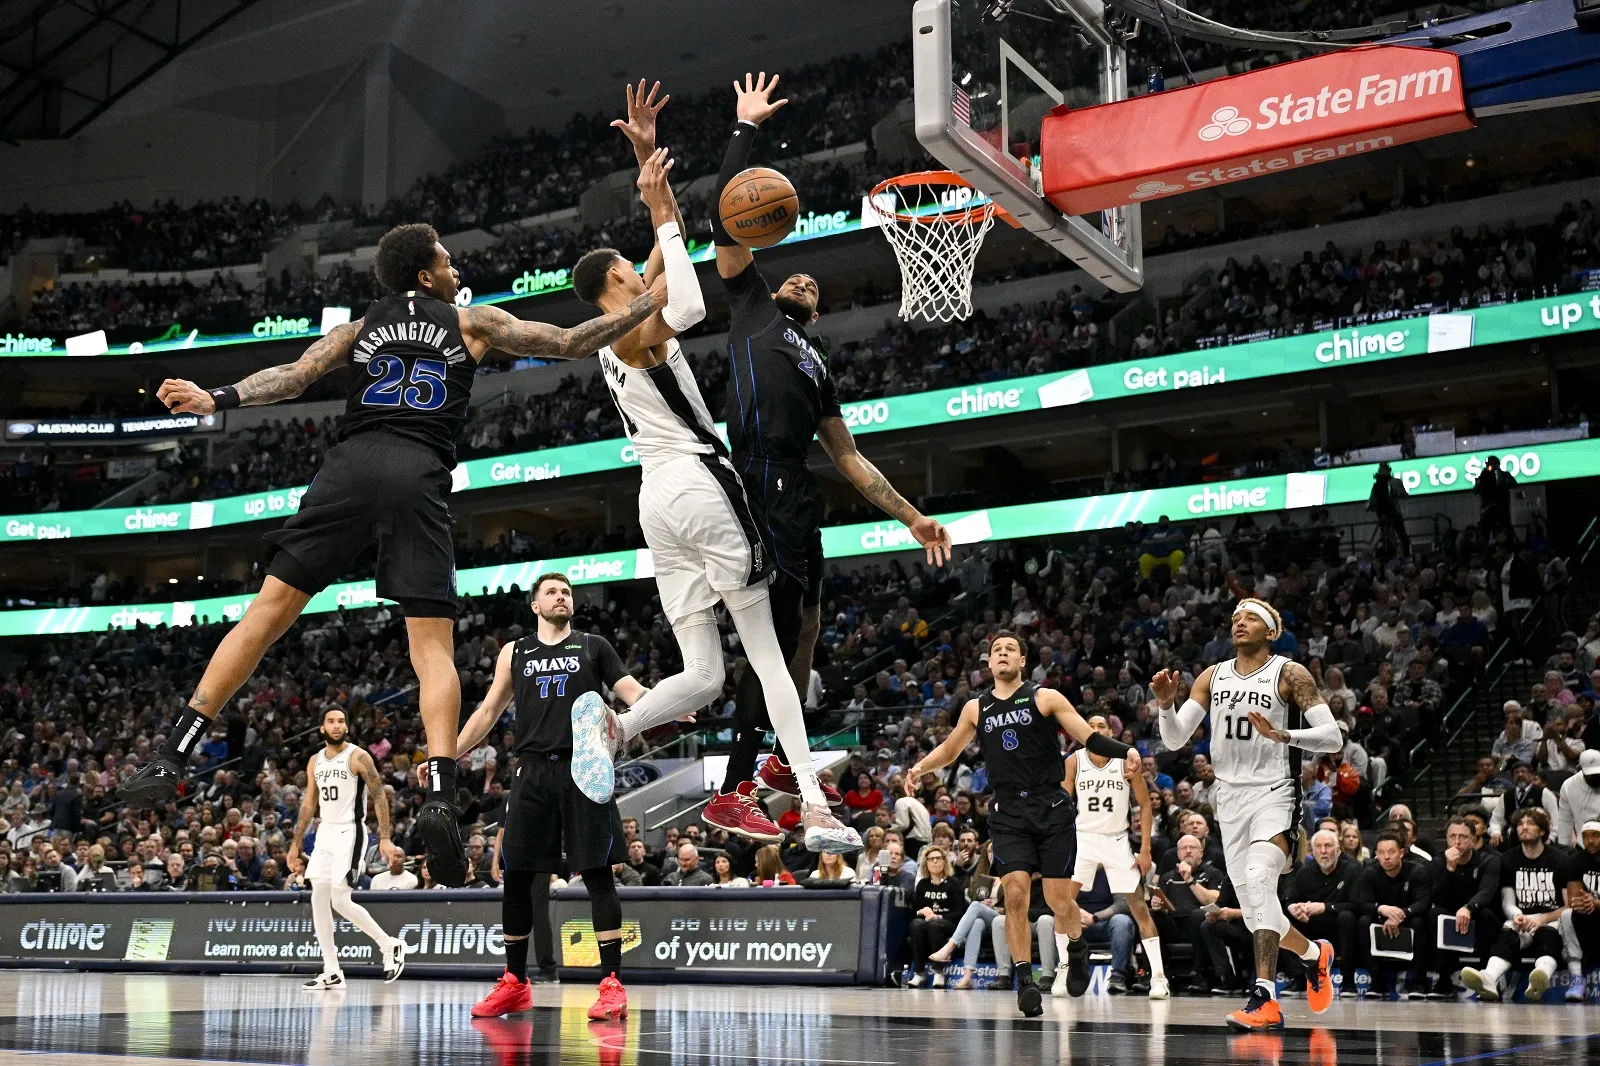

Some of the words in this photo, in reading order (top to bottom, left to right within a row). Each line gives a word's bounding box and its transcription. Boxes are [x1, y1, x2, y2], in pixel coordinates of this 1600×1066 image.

[785, 210, 847, 239] hime
[512, 268, 568, 294] chime
[252, 315, 310, 338] chime
[1540, 302, 1583, 330] up
[353, 321, 448, 364] WASHINGTON
[1314, 329, 1405, 363] chime
[361, 354, 447, 411] 25
[1124, 366, 1168, 390] Get
[946, 386, 1021, 417] chime
[840, 401, 889, 428] 200
[490, 462, 521, 481] Get
[1426, 463, 1457, 486] to
[244, 498, 265, 518] up
[267, 493, 284, 511] to
[1187, 484, 1267, 515] chime
[6, 520, 35, 538] Get
[124, 508, 178, 530] chime
[567, 557, 623, 581] chime
[523, 656, 581, 677] MAVS
[535, 674, 569, 698] 77
[1213, 690, 1272, 711] SPURS
[984, 708, 1032, 733] MAVS
[1224, 715, 1253, 740] 10
[1001, 728, 1019, 750] 8
[321, 785, 339, 801] 30
[1079, 779, 1123, 794] SPURS
[1088, 796, 1114, 812] 24
[20, 918, 105, 951] chime
[204, 940, 240, 957] Learn
[243, 943, 278, 957] more
[280, 941, 294, 957] at
[654, 936, 681, 960] of
[685, 941, 740, 967] your
[746, 941, 832, 968] money
